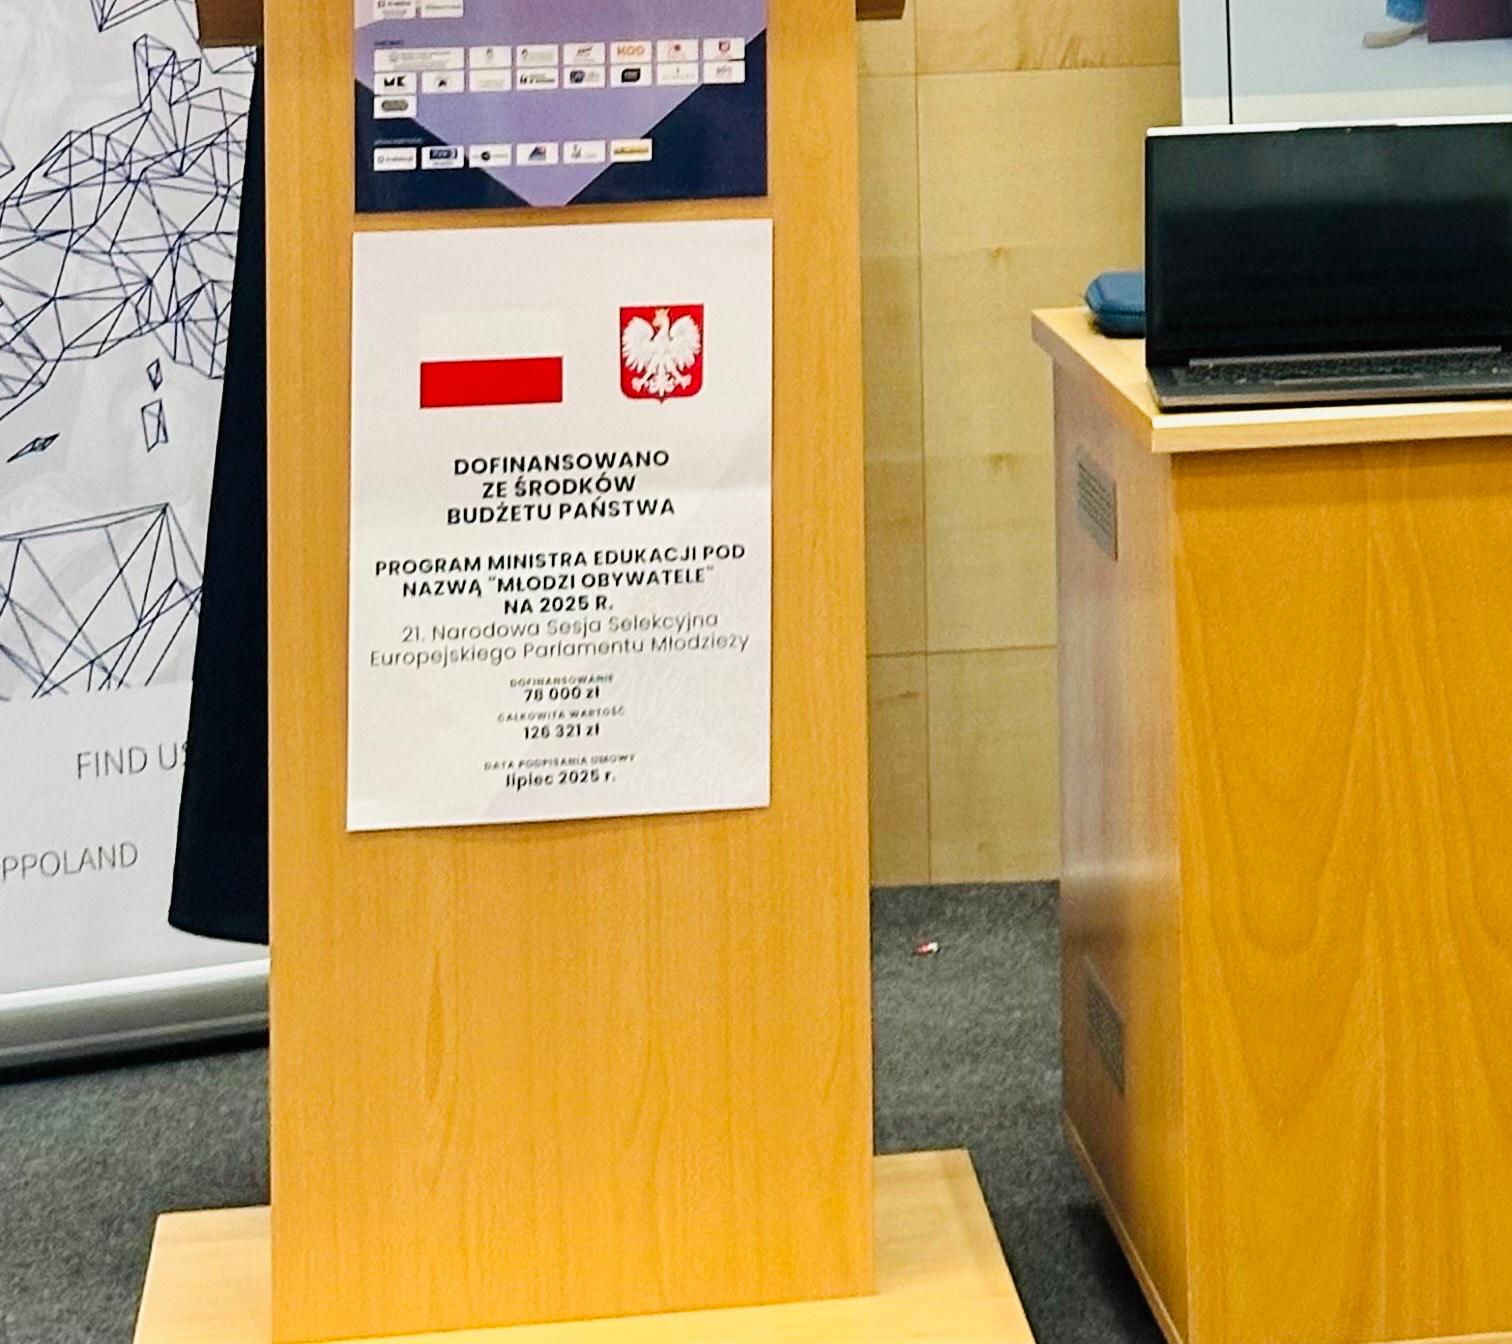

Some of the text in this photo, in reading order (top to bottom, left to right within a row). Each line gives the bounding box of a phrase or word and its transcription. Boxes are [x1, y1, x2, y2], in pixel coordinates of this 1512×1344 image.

[454, 450, 670, 475] DOFINANSOWANO
[482, 472, 636, 499] ZE ŚRODKÓW
[447, 496, 675, 525] BUDŻETU PAŃSTWA
[375, 544, 745, 576] PROGRAM MINISTRA EDUKACJI POD
[403, 579, 482, 598] NAZWĄ
[504, 595, 614, 614] NA 2025 R.
[402, 611, 718, 643] 21. Narodowa Sesja Selekcyjna
[370, 632, 749, 669] Europejskiego Parlamentu Młodzieży
[525, 688, 543, 702] 78
[550, 686, 581, 700] 000
[524, 725, 550, 739] 126
[555, 723, 581, 738] 321
[77, 745, 148, 780] FIND
[506, 771, 553, 791] lipiec
[558, 768, 599, 785] 2025
